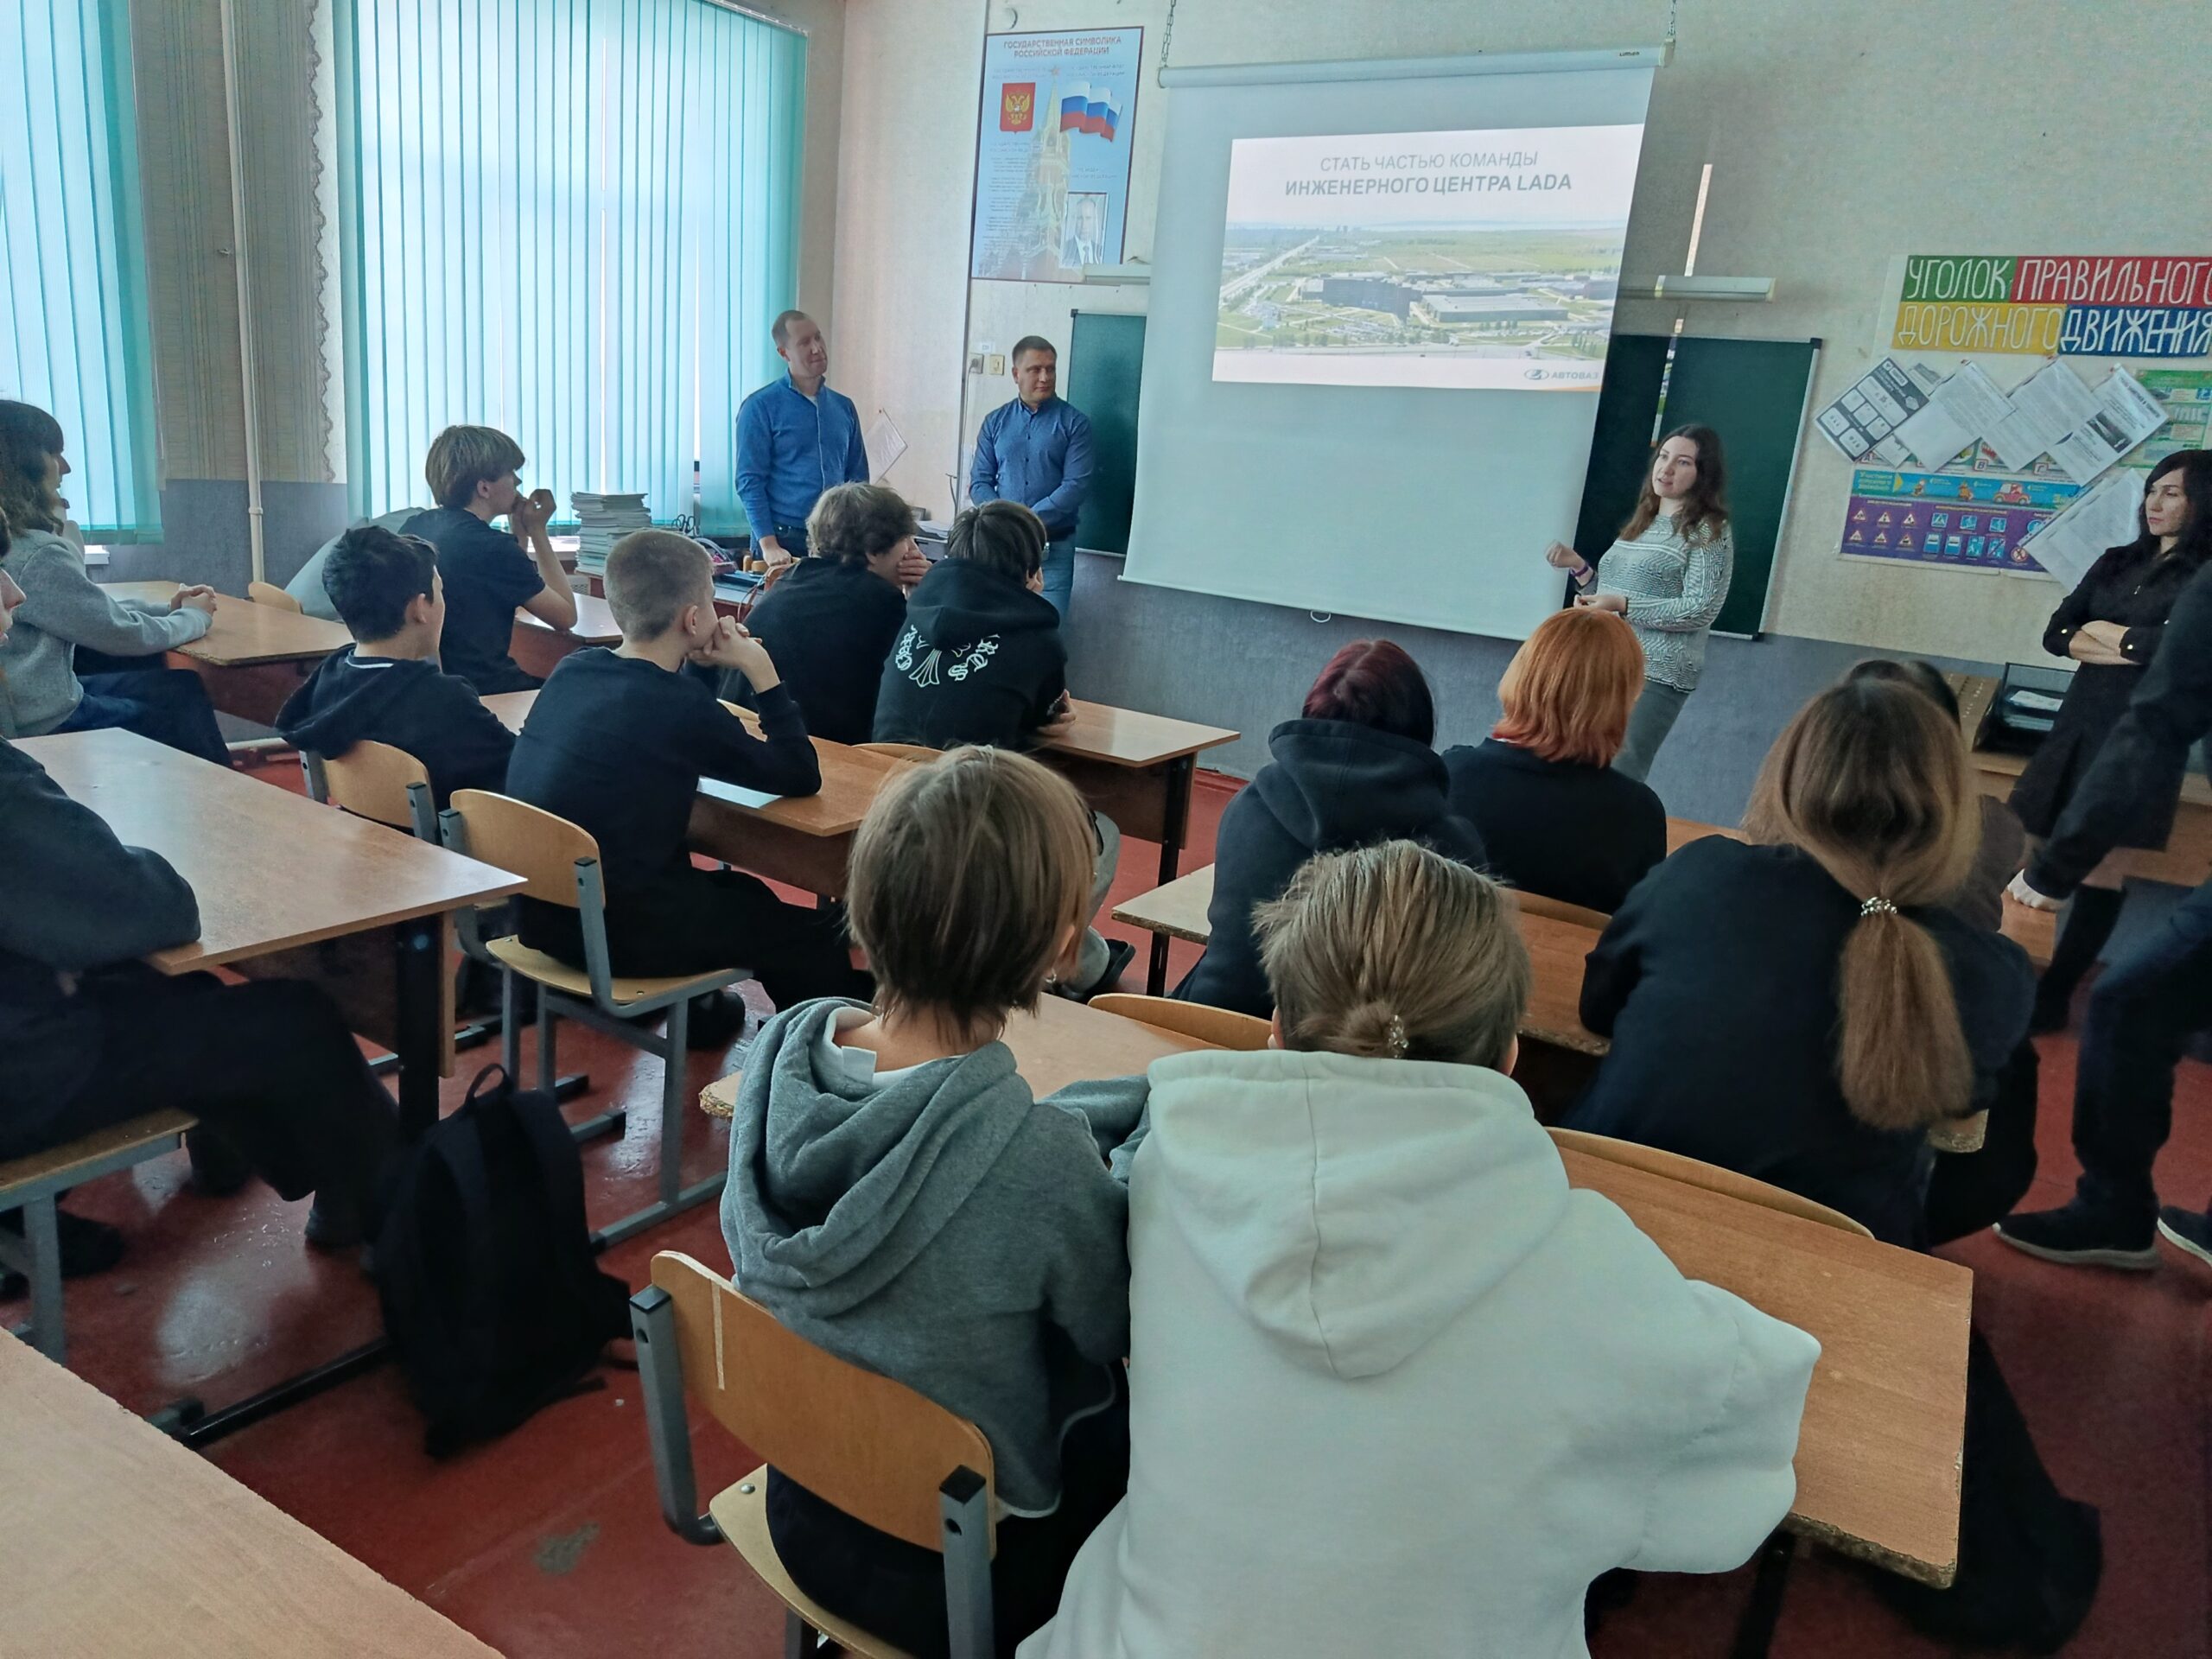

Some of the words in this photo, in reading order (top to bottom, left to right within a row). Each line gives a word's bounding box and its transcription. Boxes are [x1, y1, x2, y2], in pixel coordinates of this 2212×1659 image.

[1003, 38, 1074, 49] ГОСУДАРСТВЕННАЯ
[1075, 36, 1122, 47] СИМВОЛИКА
[1014, 47, 1063, 58] РОССИЙСКОЙ
[1064, 46, 1109, 56] ФЕДЕРАЦИИ
[1319, 156, 1371, 172] СТАТЬ
[1374, 154, 1446, 170] ЧАСТЬЮ
[1449, 151, 1539, 169] КОМАНДЫ
[1285, 176, 1429, 196] ИНЖЕНЕРНОГО
[1433, 175, 1512, 195] ЦЕНТРА
[1516, 173, 1573, 192] LADA
[1906, 258, 2011, 300] УГОЛОК
[1897, 304, 2064, 350] ДОРОЖНОГО
[2060, 308, 2212, 354] ДВИЖЕНИЯ
[1551, 372, 1599, 380] АВТОВАЗ
